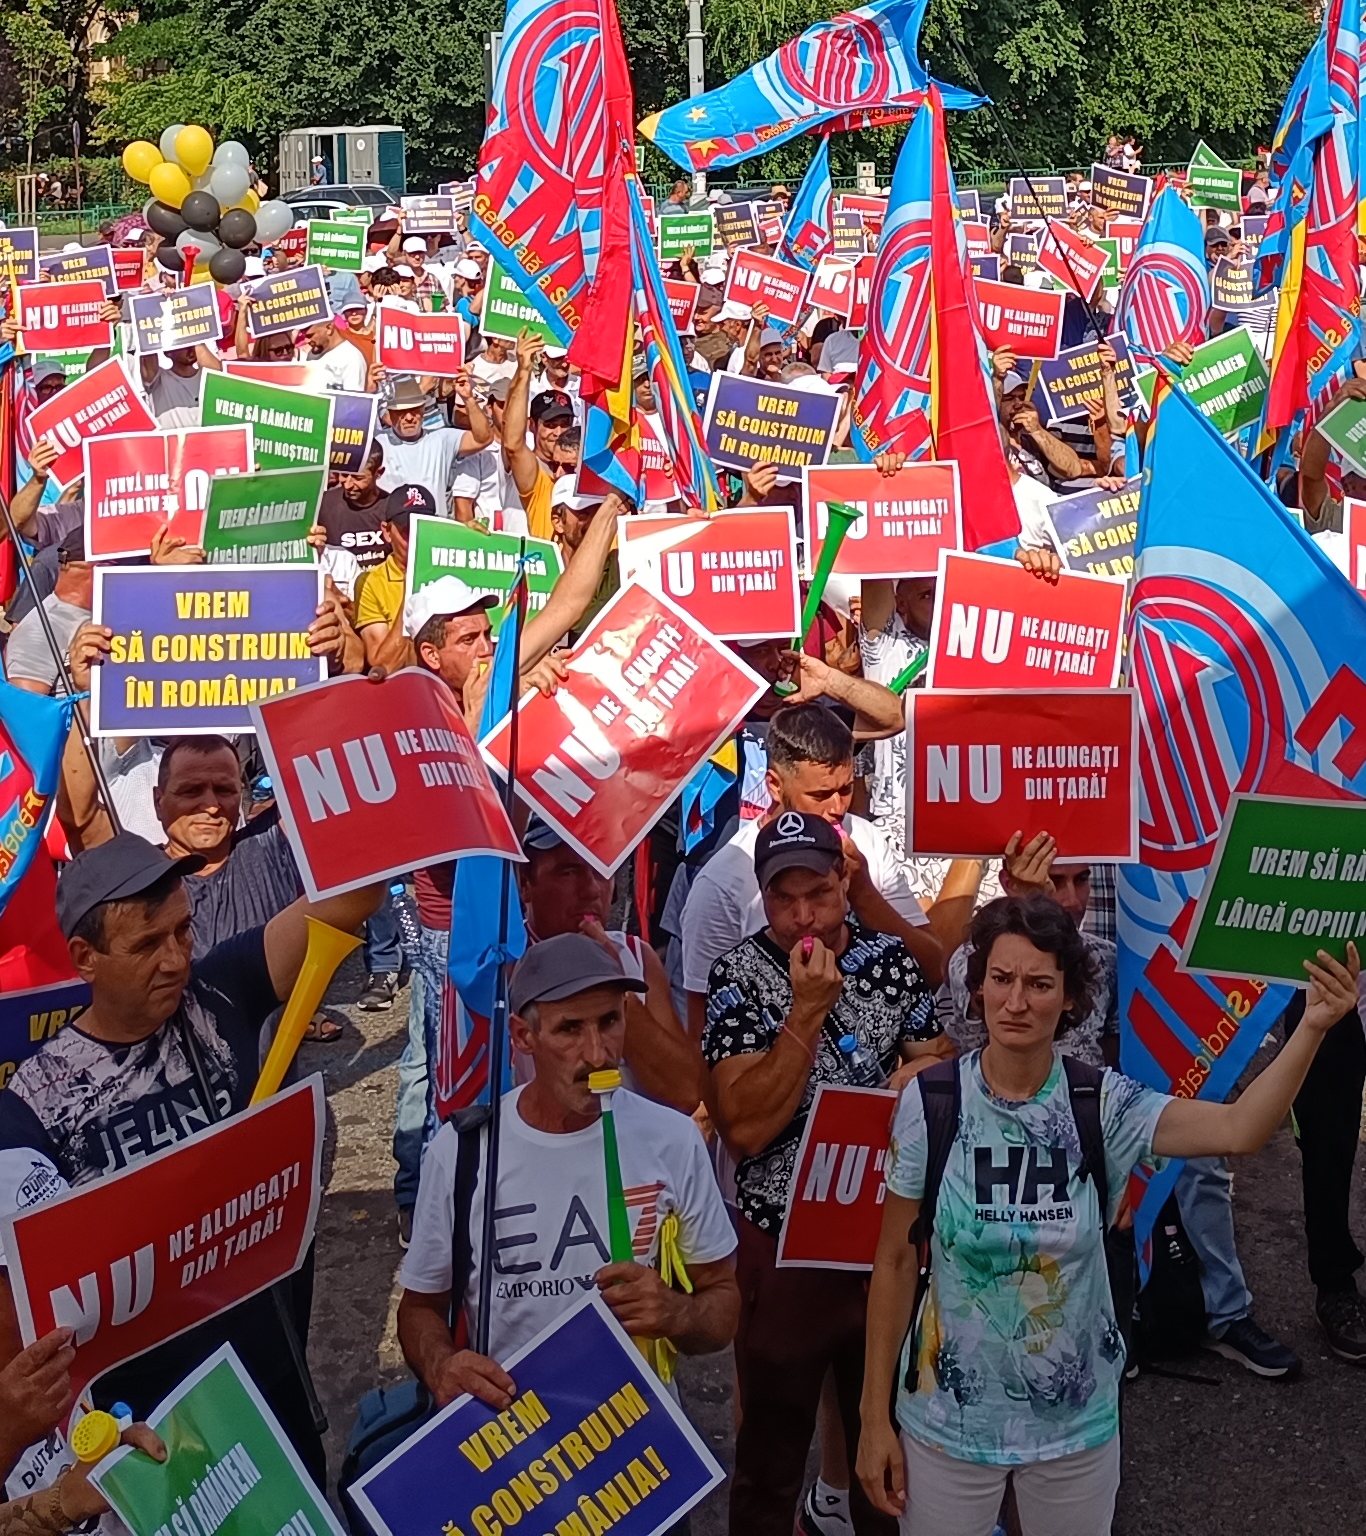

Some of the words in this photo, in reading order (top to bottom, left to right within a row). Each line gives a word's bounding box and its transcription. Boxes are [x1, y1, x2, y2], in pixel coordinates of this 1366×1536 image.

[252, 299, 268, 314] SĂ
[269, 287, 322, 311] CONSTRUIM
[270, 279, 298, 294] VREM
[259, 312, 273, 325] ÎN
[274, 303, 319, 324] ROMÂNIA!
[757, 395, 798, 415] VREM
[715, 410, 737, 429] SĂ
[740, 415, 826, 445] CONSTRUIM
[719, 434, 737, 455] ÎN
[739, 440, 813, 466] ROMÂNIA!
[341, 531, 384, 547] SEX
[175, 591, 249, 618] VREM
[110, 631, 145, 663] SĂ
[152, 633, 311, 662] CONSTRUIM
[946, 603, 1014, 664] NU
[1020, 617, 1040, 639] NE
[1042, 620, 1109, 654] ALUNGAȚI
[1025, 646, 1052, 669] DIN
[1054, 649, 1096, 676] ȚARĂ!
[125, 677, 154, 708] ÎN
[160, 675, 296, 708] ROMÂNIA!
[926, 745, 1002, 804] NU
[1012, 746, 1033, 768] NE
[1036, 745, 1119, 775] ALUNGAȚI
[292, 733, 397, 823] NU
[1025, 777, 1053, 800] DIN
[1058, 775, 1106, 806] ȚARĂ!
[1249, 846, 1309, 879] VREM
[1310, 848, 1338, 881] SĂ
[1215, 897, 1286, 933] LÂNGĂ
[1288, 908, 1354, 938] COPIII
[802, 1142, 871, 1205] NU
[974, 1147, 1071, 1205] HH
[169, 1227, 195, 1260] NE
[199, 1164, 299, 1248] ALUNGAȚI
[974, 1208, 1015, 1222] HELLY
[1019, 1207, 1074, 1222] HANSEN
[181, 1252, 218, 1287] DIN
[222, 1209, 283, 1272] ȚARĂ!
[49, 1242, 154, 1347] NU
[496, 1277, 573, 1299] EMPORIO
